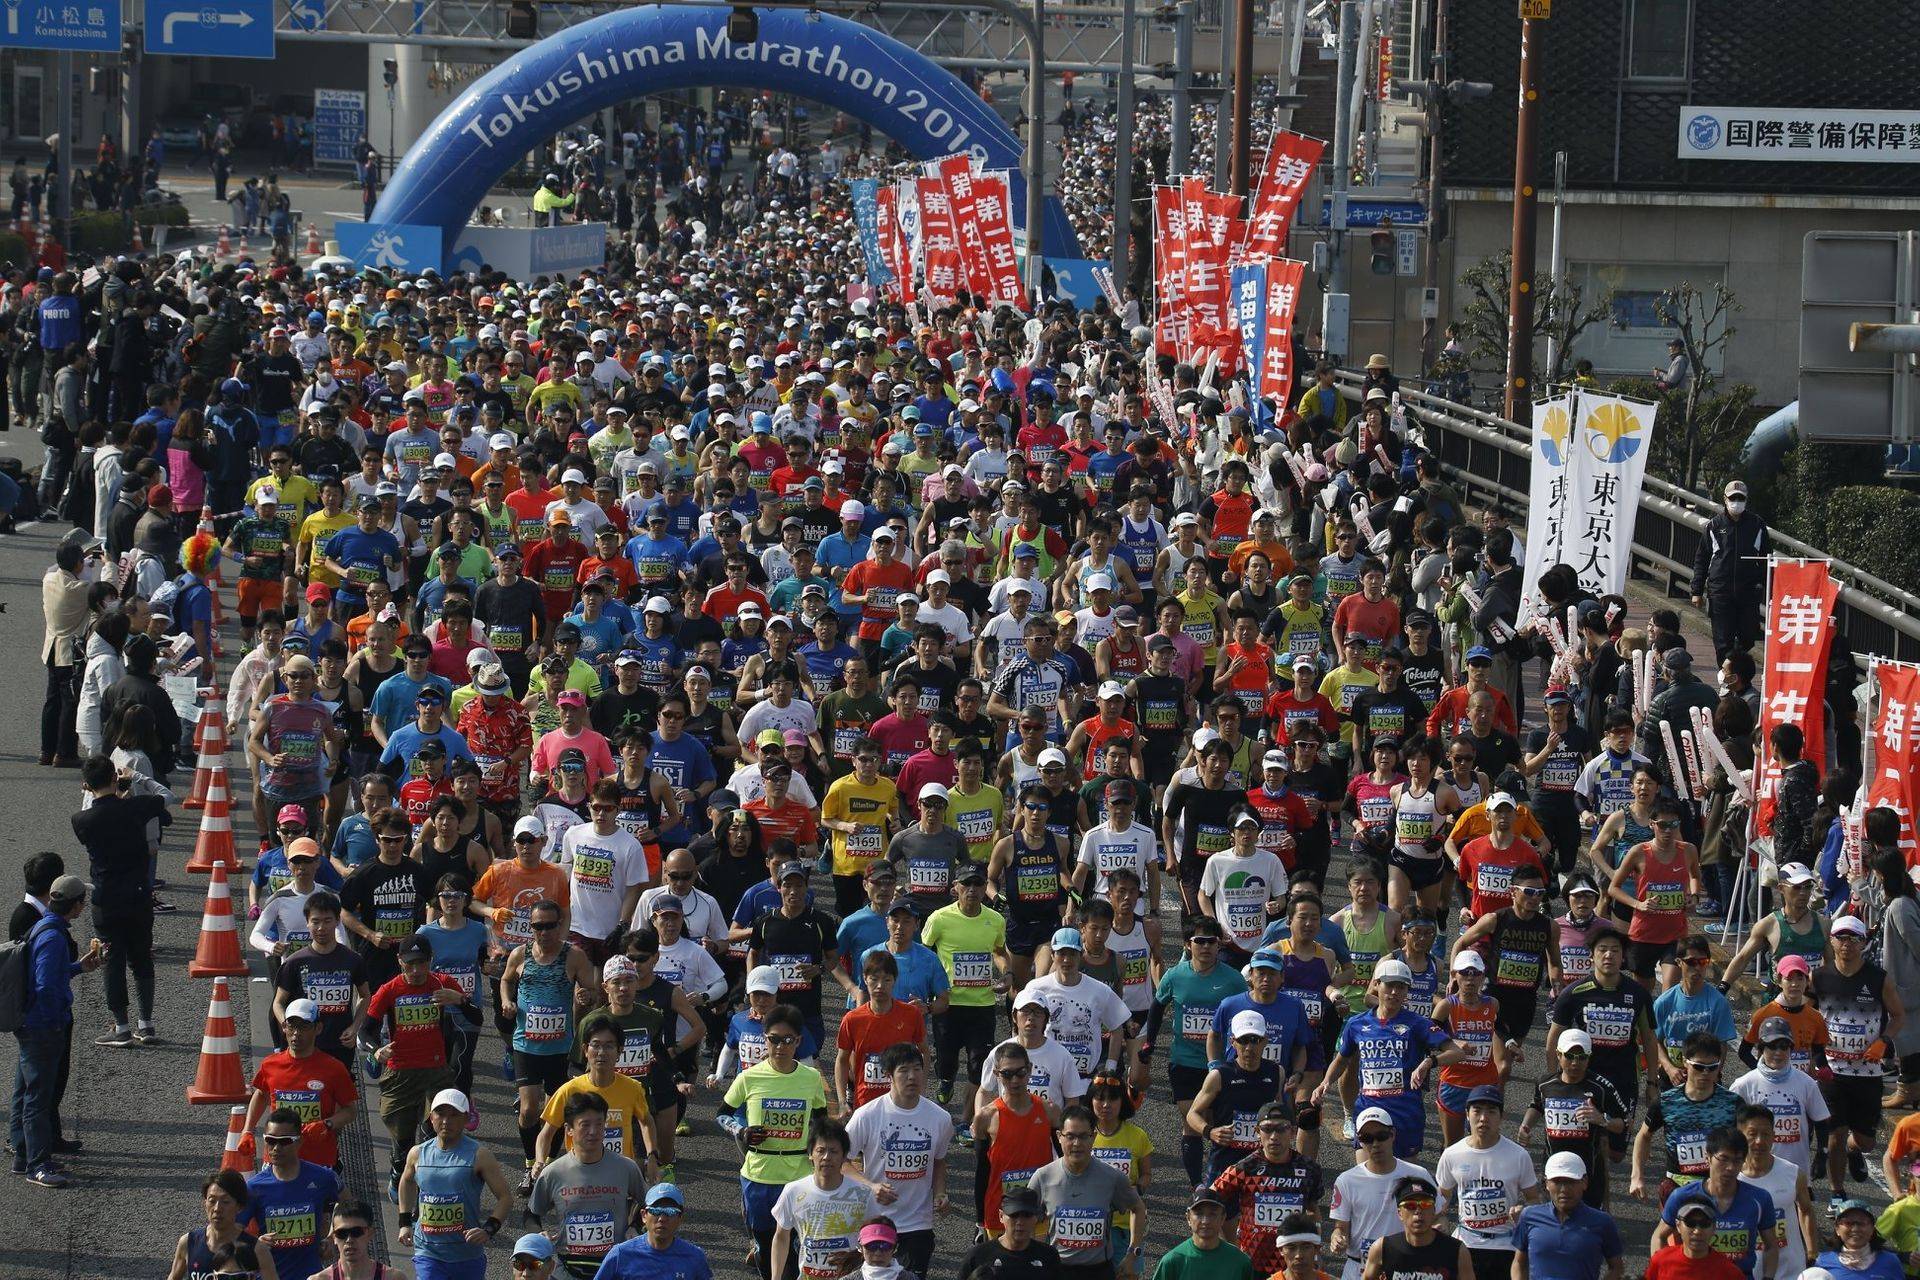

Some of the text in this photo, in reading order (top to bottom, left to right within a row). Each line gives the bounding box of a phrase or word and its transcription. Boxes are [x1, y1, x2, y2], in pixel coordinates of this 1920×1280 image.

[36, 6, 105, 26] 小松島
[35, 25, 107, 38] Komatsushima
[461, 41, 685, 148] Tokushima
[696, 26, 898, 104] Marathon
[1727, 120, 1907, 150] 国際警備保障
[42, 309, 70, 319] PHOTO
[1290, 640, 1319, 651] S1727
[1026, 692, 1058, 705] S1557
[1370, 717, 1404, 727] A2945
[1544, 769, 1577, 782] S1445
[959, 819, 993, 835] S1749
[848, 834, 881, 847] S1691
[575, 856, 611, 873] A4393
[1100, 853, 1137, 867] S1074
[912, 869, 948, 882] S1128
[1479, 872, 1510, 888] S150
[1020, 877, 1057, 891] A2394
[373, 893, 417, 905] PRIMITIVE
[1656, 894, 1685, 907] 2310
[1501, 929, 1548, 941] AMINO
[955, 962, 991, 977] S1175
[1501, 962, 1538, 978] A2886
[310, 988, 350, 1001] S1630
[399, 1006, 439, 1023] A3199
[526, 1013, 565, 1030] S1012
[1588, 1021, 1630, 1037] S1625
[1358, 1039, 1408, 1050] POCARI
[1360, 1049, 1404, 1058] SWEAT
[1363, 1068, 1403, 1084] S1728
[278, 1092, 316, 1101] 大塚グループ
[765, 1100, 804, 1109] 大塚グループ
[763, 1110, 805, 1126] A3864
[1546, 1108, 1579, 1125] S134
[889, 1142, 930, 1151] 大塚グループ
[887, 1152, 929, 1168] S1898
[1260, 1177, 1302, 1188] JAPAN
[423, 1194, 459, 1203] 大塚グループ
[1260, 1194, 1301, 1204] 大塚グループ
[268, 1205, 310, 1217] 大塚グループ
[421, 1204, 464, 1221] A2206
[1061, 1208, 1101, 1218] 大塚グループ
[1464, 1201, 1507, 1217] S1385
[569, 1213, 610, 1223] 大塚グループ
[270, 1216, 314, 1234] A2711
[1058, 1218, 1103, 1236] S1608
[568, 1224, 613, 1241] S1736
[1711, 1232, 1748, 1249] 2468
